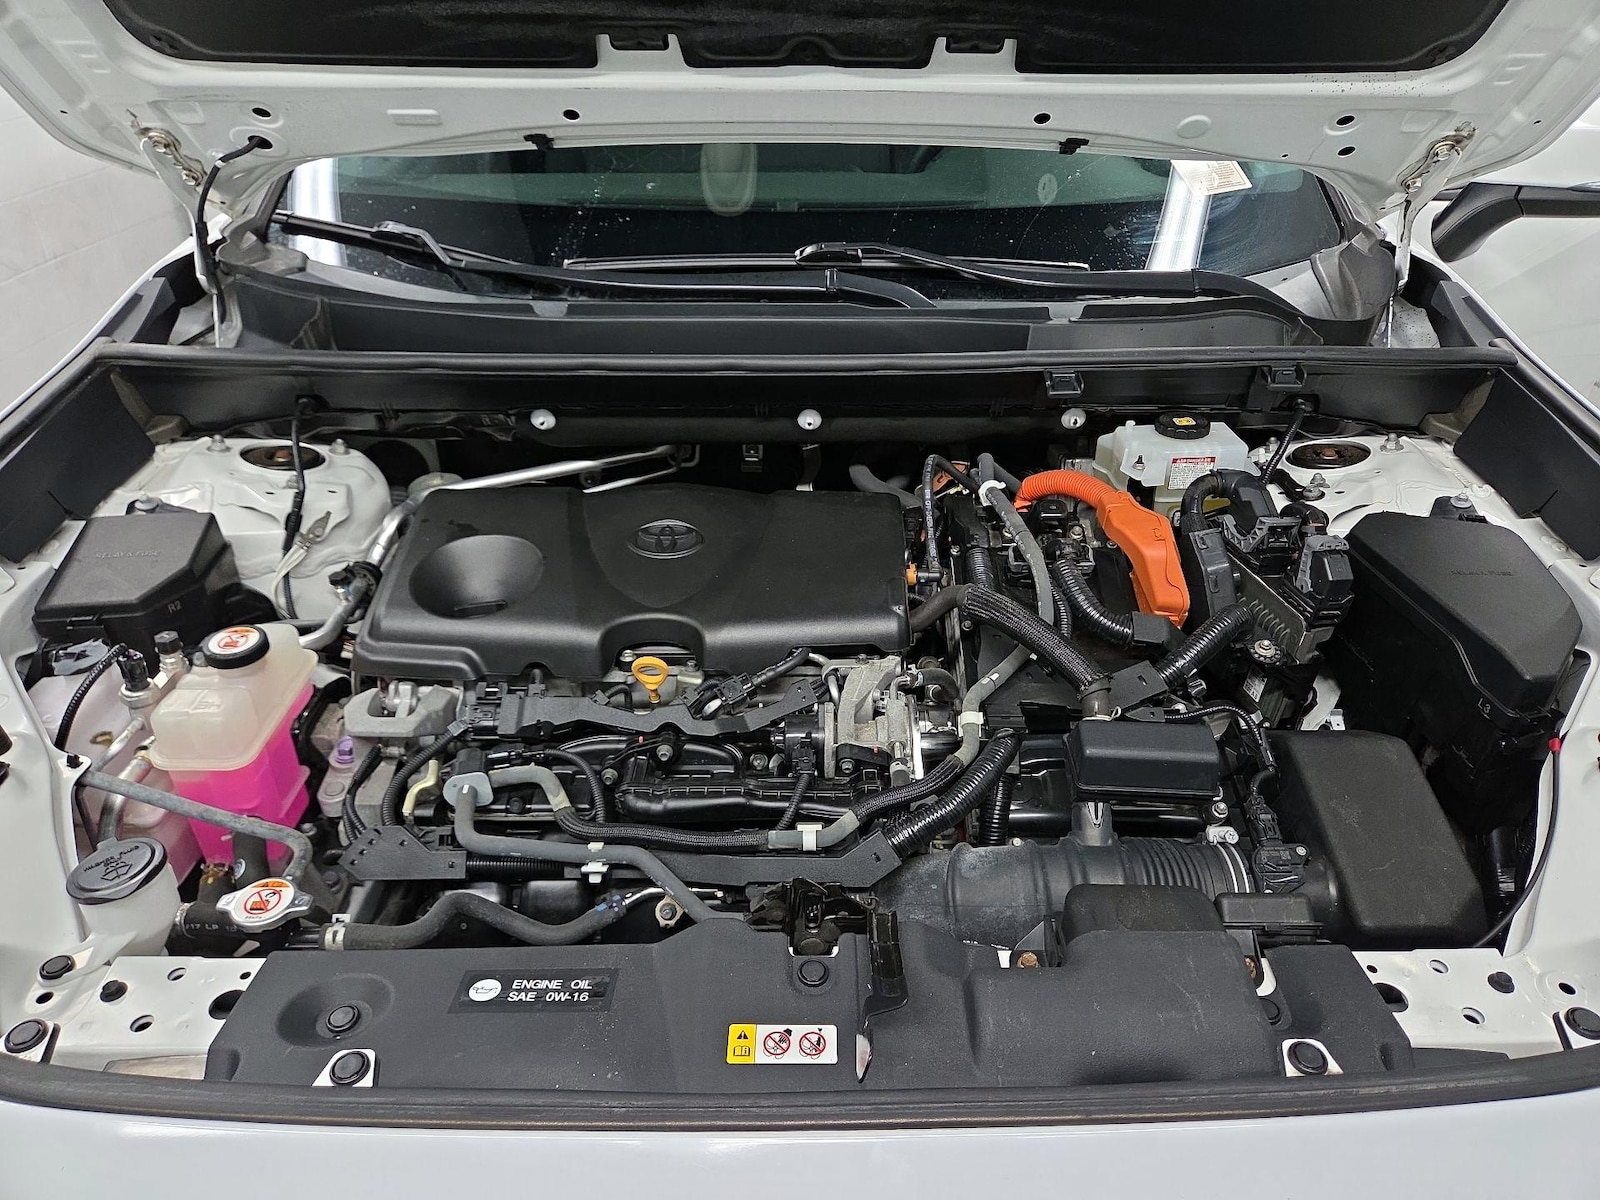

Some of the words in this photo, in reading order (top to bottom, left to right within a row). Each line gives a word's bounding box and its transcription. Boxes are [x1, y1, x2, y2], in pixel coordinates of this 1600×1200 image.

[168, 600, 181, 613] R2
[1478, 697, 1490, 713] L3
[512, 979, 563, 989] ENGINE
[570, 979, 593, 989] OIL
[507, 991, 537, 1002] SAE
[545, 991, 589, 1002] 0W-16
